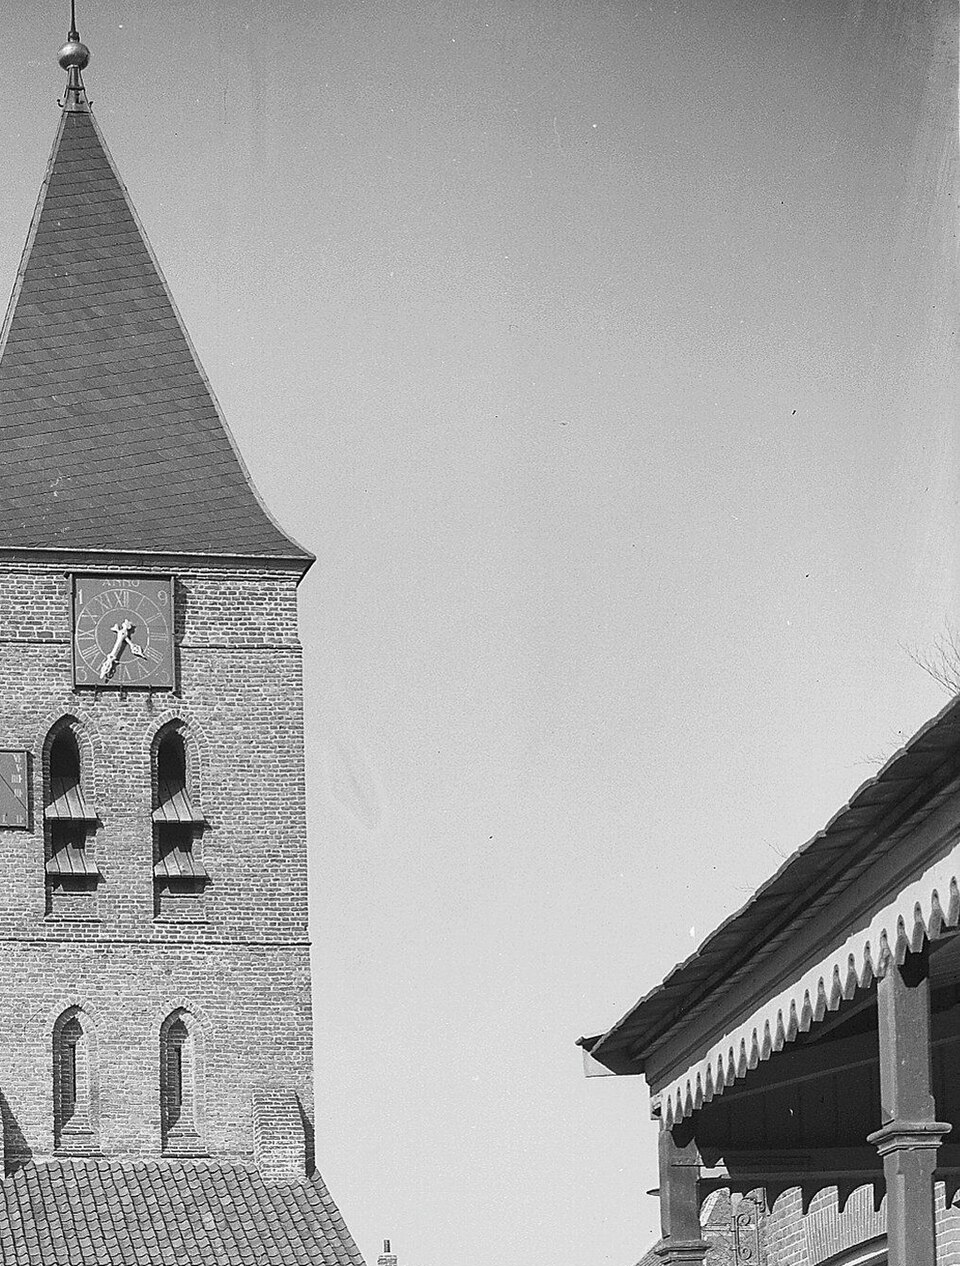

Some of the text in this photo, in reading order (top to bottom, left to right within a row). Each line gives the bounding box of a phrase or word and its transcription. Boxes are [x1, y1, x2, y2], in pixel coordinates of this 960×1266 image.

[78, 589, 83, 605] 1
[114, 590, 129, 609] XII
[157, 590, 168, 607] 9
